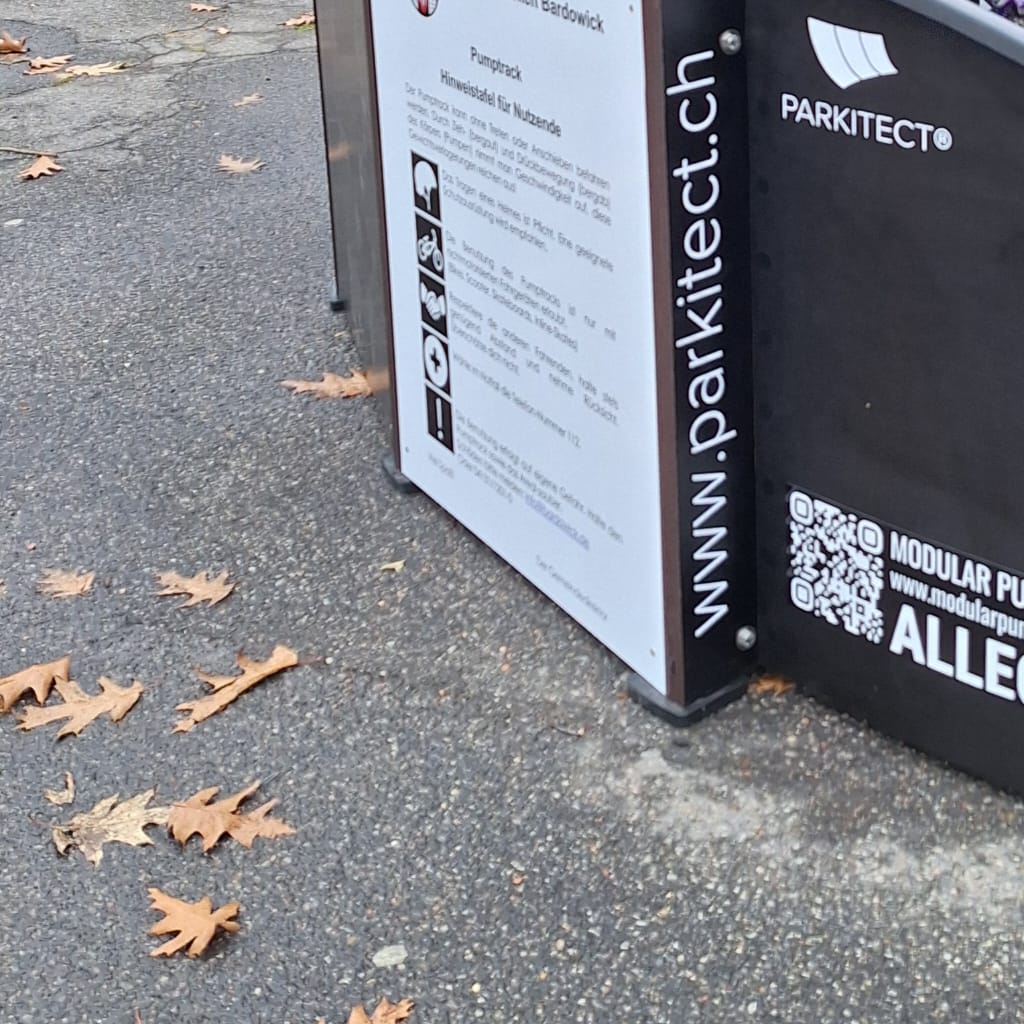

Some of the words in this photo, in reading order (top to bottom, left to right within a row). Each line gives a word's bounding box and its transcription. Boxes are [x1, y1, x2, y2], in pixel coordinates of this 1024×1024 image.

[470, 46, 523, 82] Pumptrack
[440, 69, 496, 109] Hinweistafel
[497, 94, 513, 115] für
[513, 103, 562, 138] Nutzende
[666, 49, 737, 638] www.parkitect.ch
[890, 530, 991, 597] MODULAR
